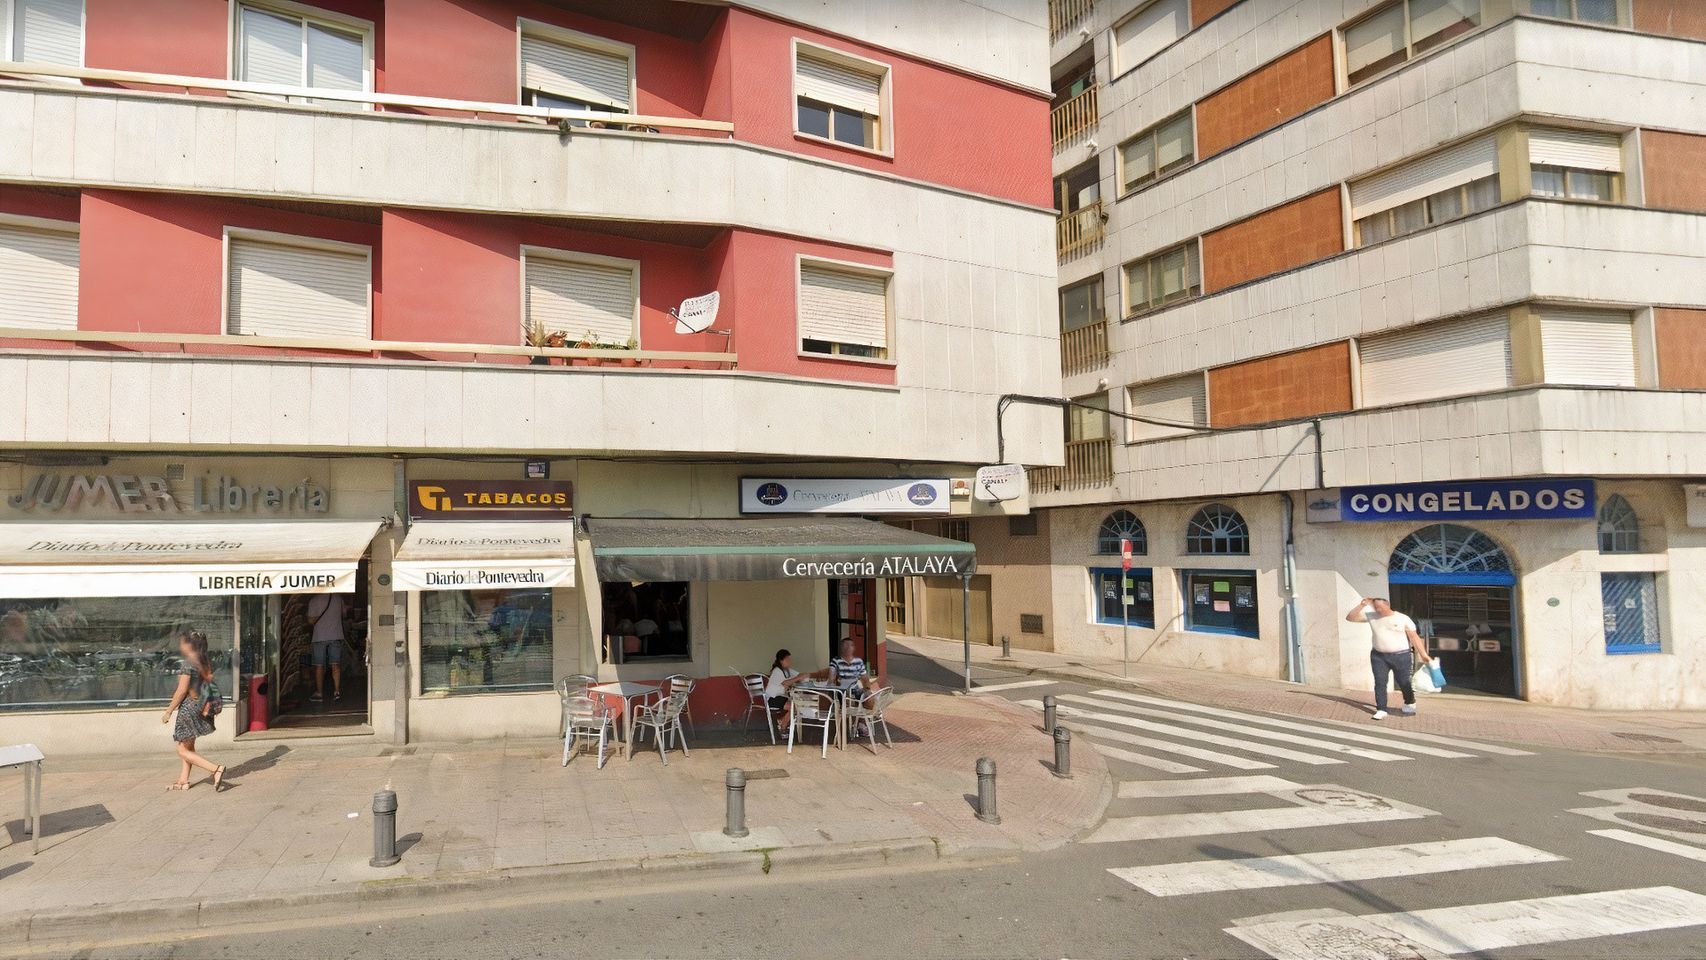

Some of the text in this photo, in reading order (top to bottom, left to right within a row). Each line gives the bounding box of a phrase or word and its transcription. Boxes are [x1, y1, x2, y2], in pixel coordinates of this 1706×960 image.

[8, 474, 183, 513] JUMER
[463, 492, 566, 505] TABACOS
[1350, 488, 1586, 514] CONGELADOS
[782, 556, 958, 578] Cervecería ATALAYA
[199, 573, 336, 590] LIBRERÍA JUMER
